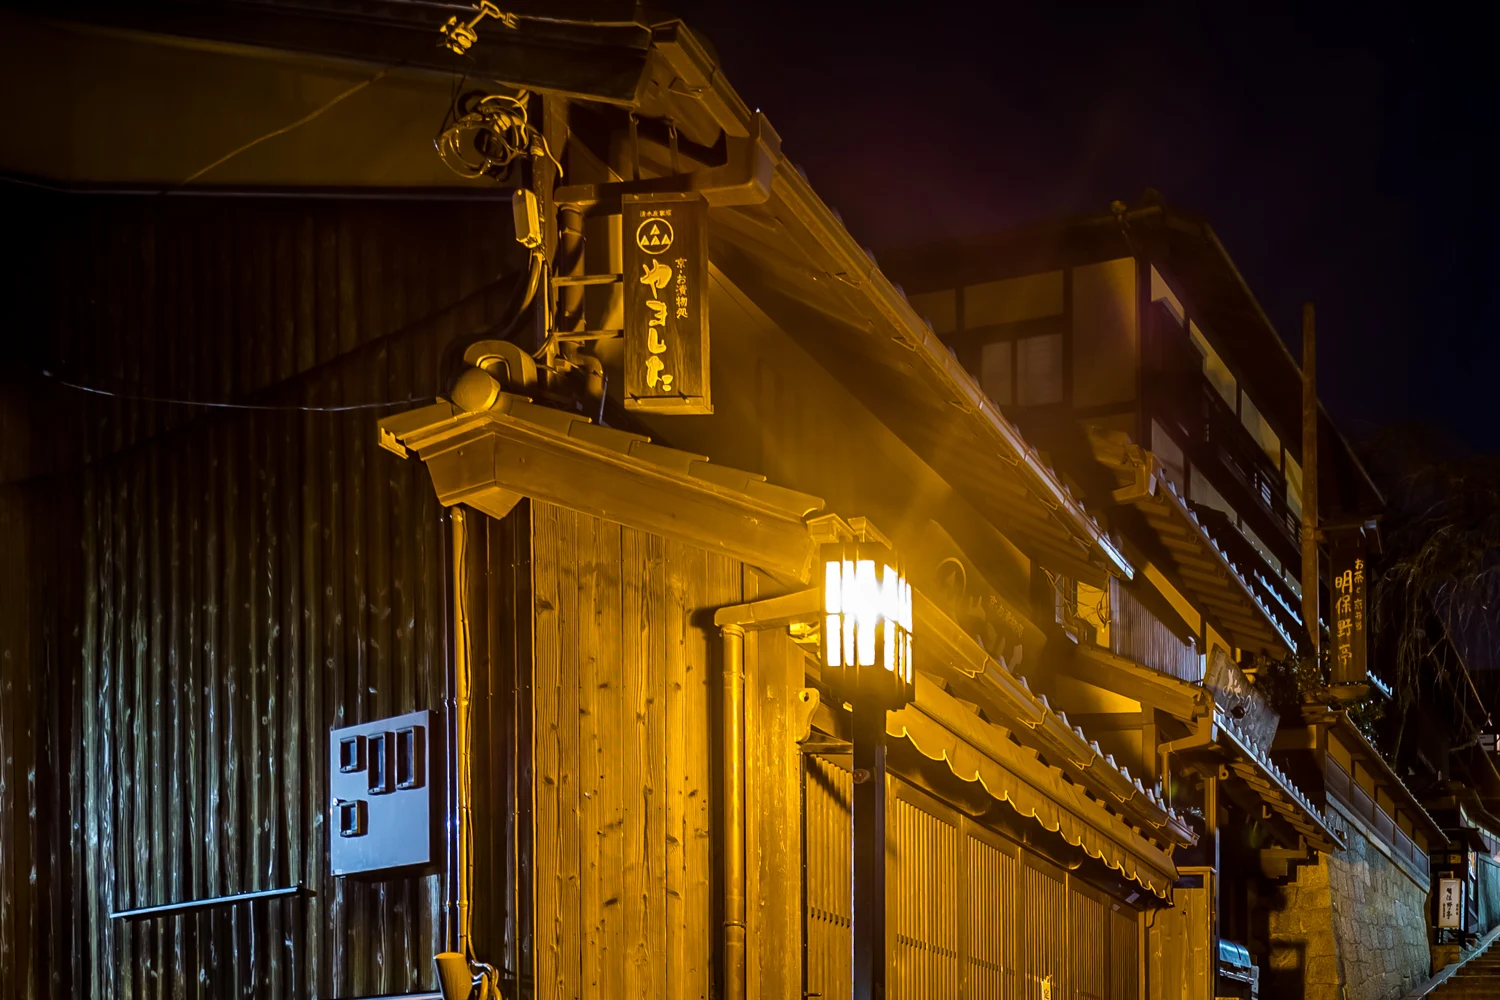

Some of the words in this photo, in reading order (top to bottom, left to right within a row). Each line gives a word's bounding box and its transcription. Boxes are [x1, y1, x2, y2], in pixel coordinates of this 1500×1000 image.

[639, 258, 674, 392] やました
[1334, 569, 1354, 665] 明保野亭
